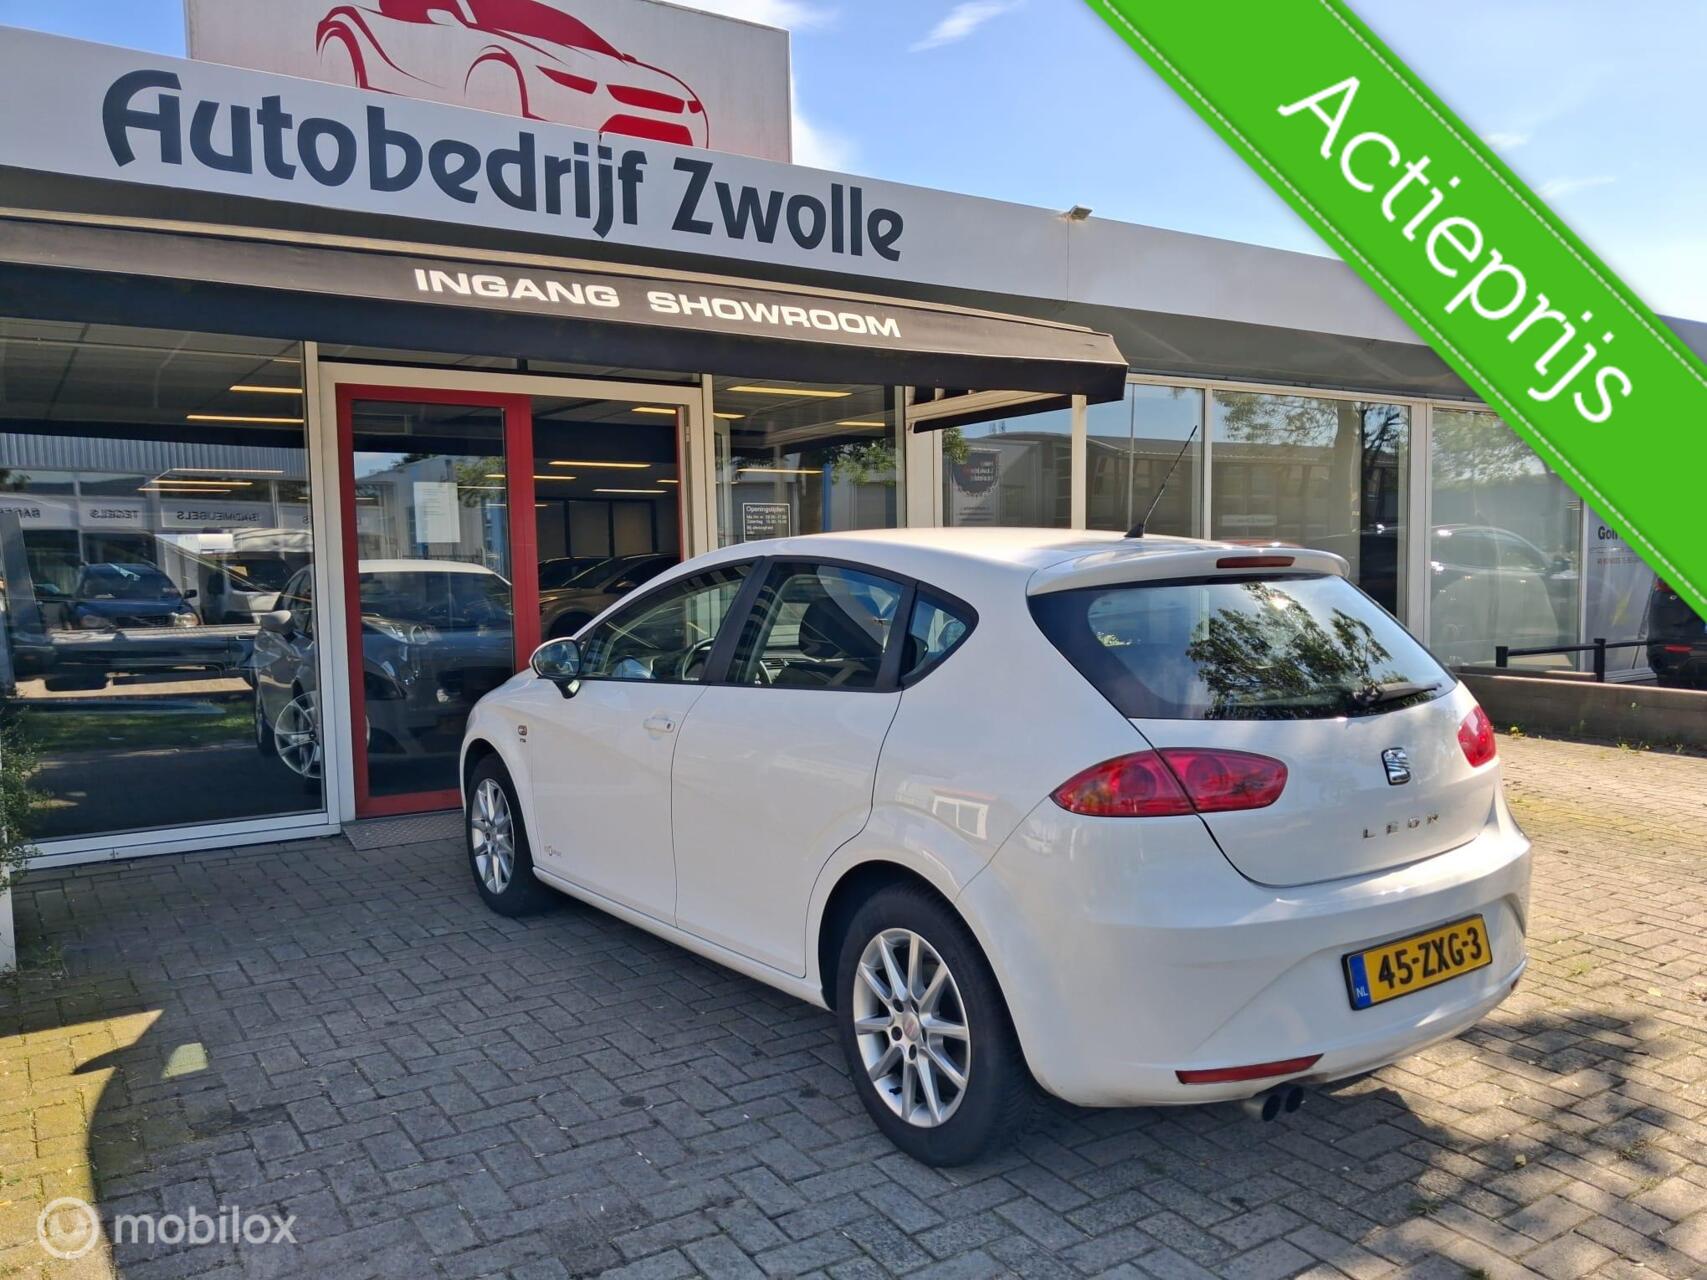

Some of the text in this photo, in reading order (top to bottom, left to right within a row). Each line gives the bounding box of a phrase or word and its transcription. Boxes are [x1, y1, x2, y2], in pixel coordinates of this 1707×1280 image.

[102, 69, 904, 262] Autobedrijf Zwolle
[414, 268, 902, 338] INGANG SHOWROOM
[1362, 813, 1441, 839] LEON
[1378, 926, 1483, 990] 45-ZXG-3
[1356, 986, 1369, 998] NL
